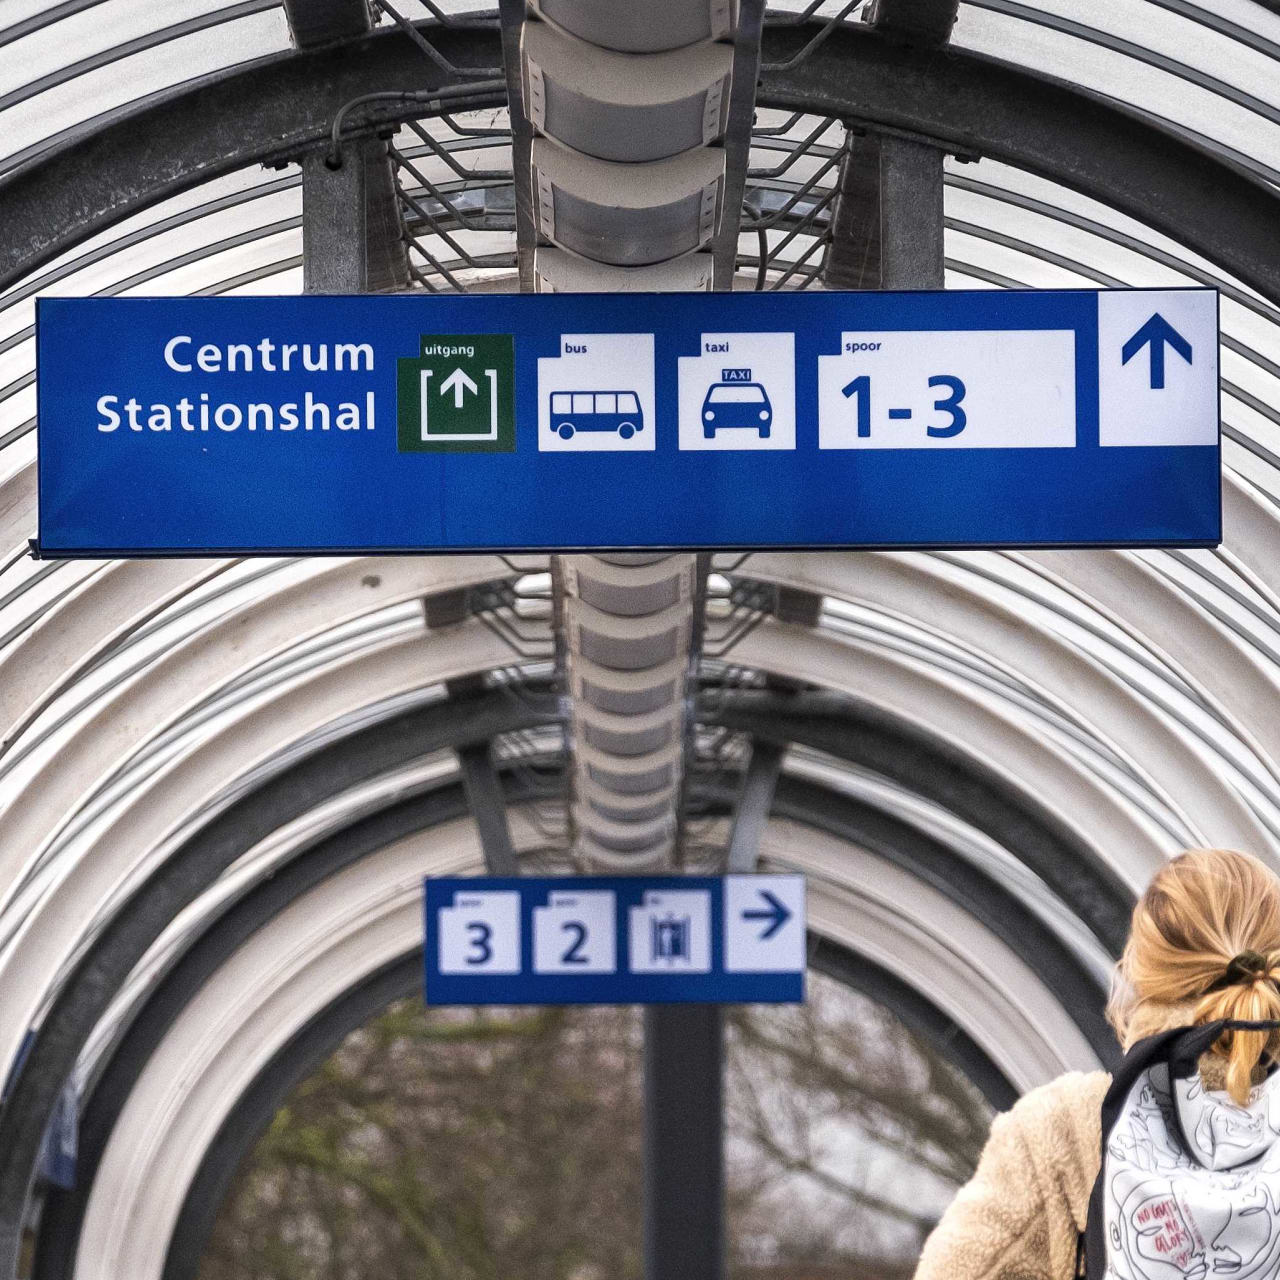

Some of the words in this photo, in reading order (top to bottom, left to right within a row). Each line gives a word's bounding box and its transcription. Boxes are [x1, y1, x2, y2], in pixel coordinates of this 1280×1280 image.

[164, 336, 374, 373] Centrum
[425, 344, 475, 358] uitgang
[565, 342, 587, 354] bus
[705, 341, 729, 353] taxi
[845, 342, 882, 354] spoor
[723, 370, 751, 380] TAXI
[96, 391, 375, 433] Stationshal
[841, 374, 967, 439] 1-3
[465, 921, 494, 966] 3
[561, 920, 590, 965] 2
[1137, 1207, 1151, 1224] NO
[1164, 1218, 1180, 1233] NO
[1154, 1228, 1189, 1254] GLORY
